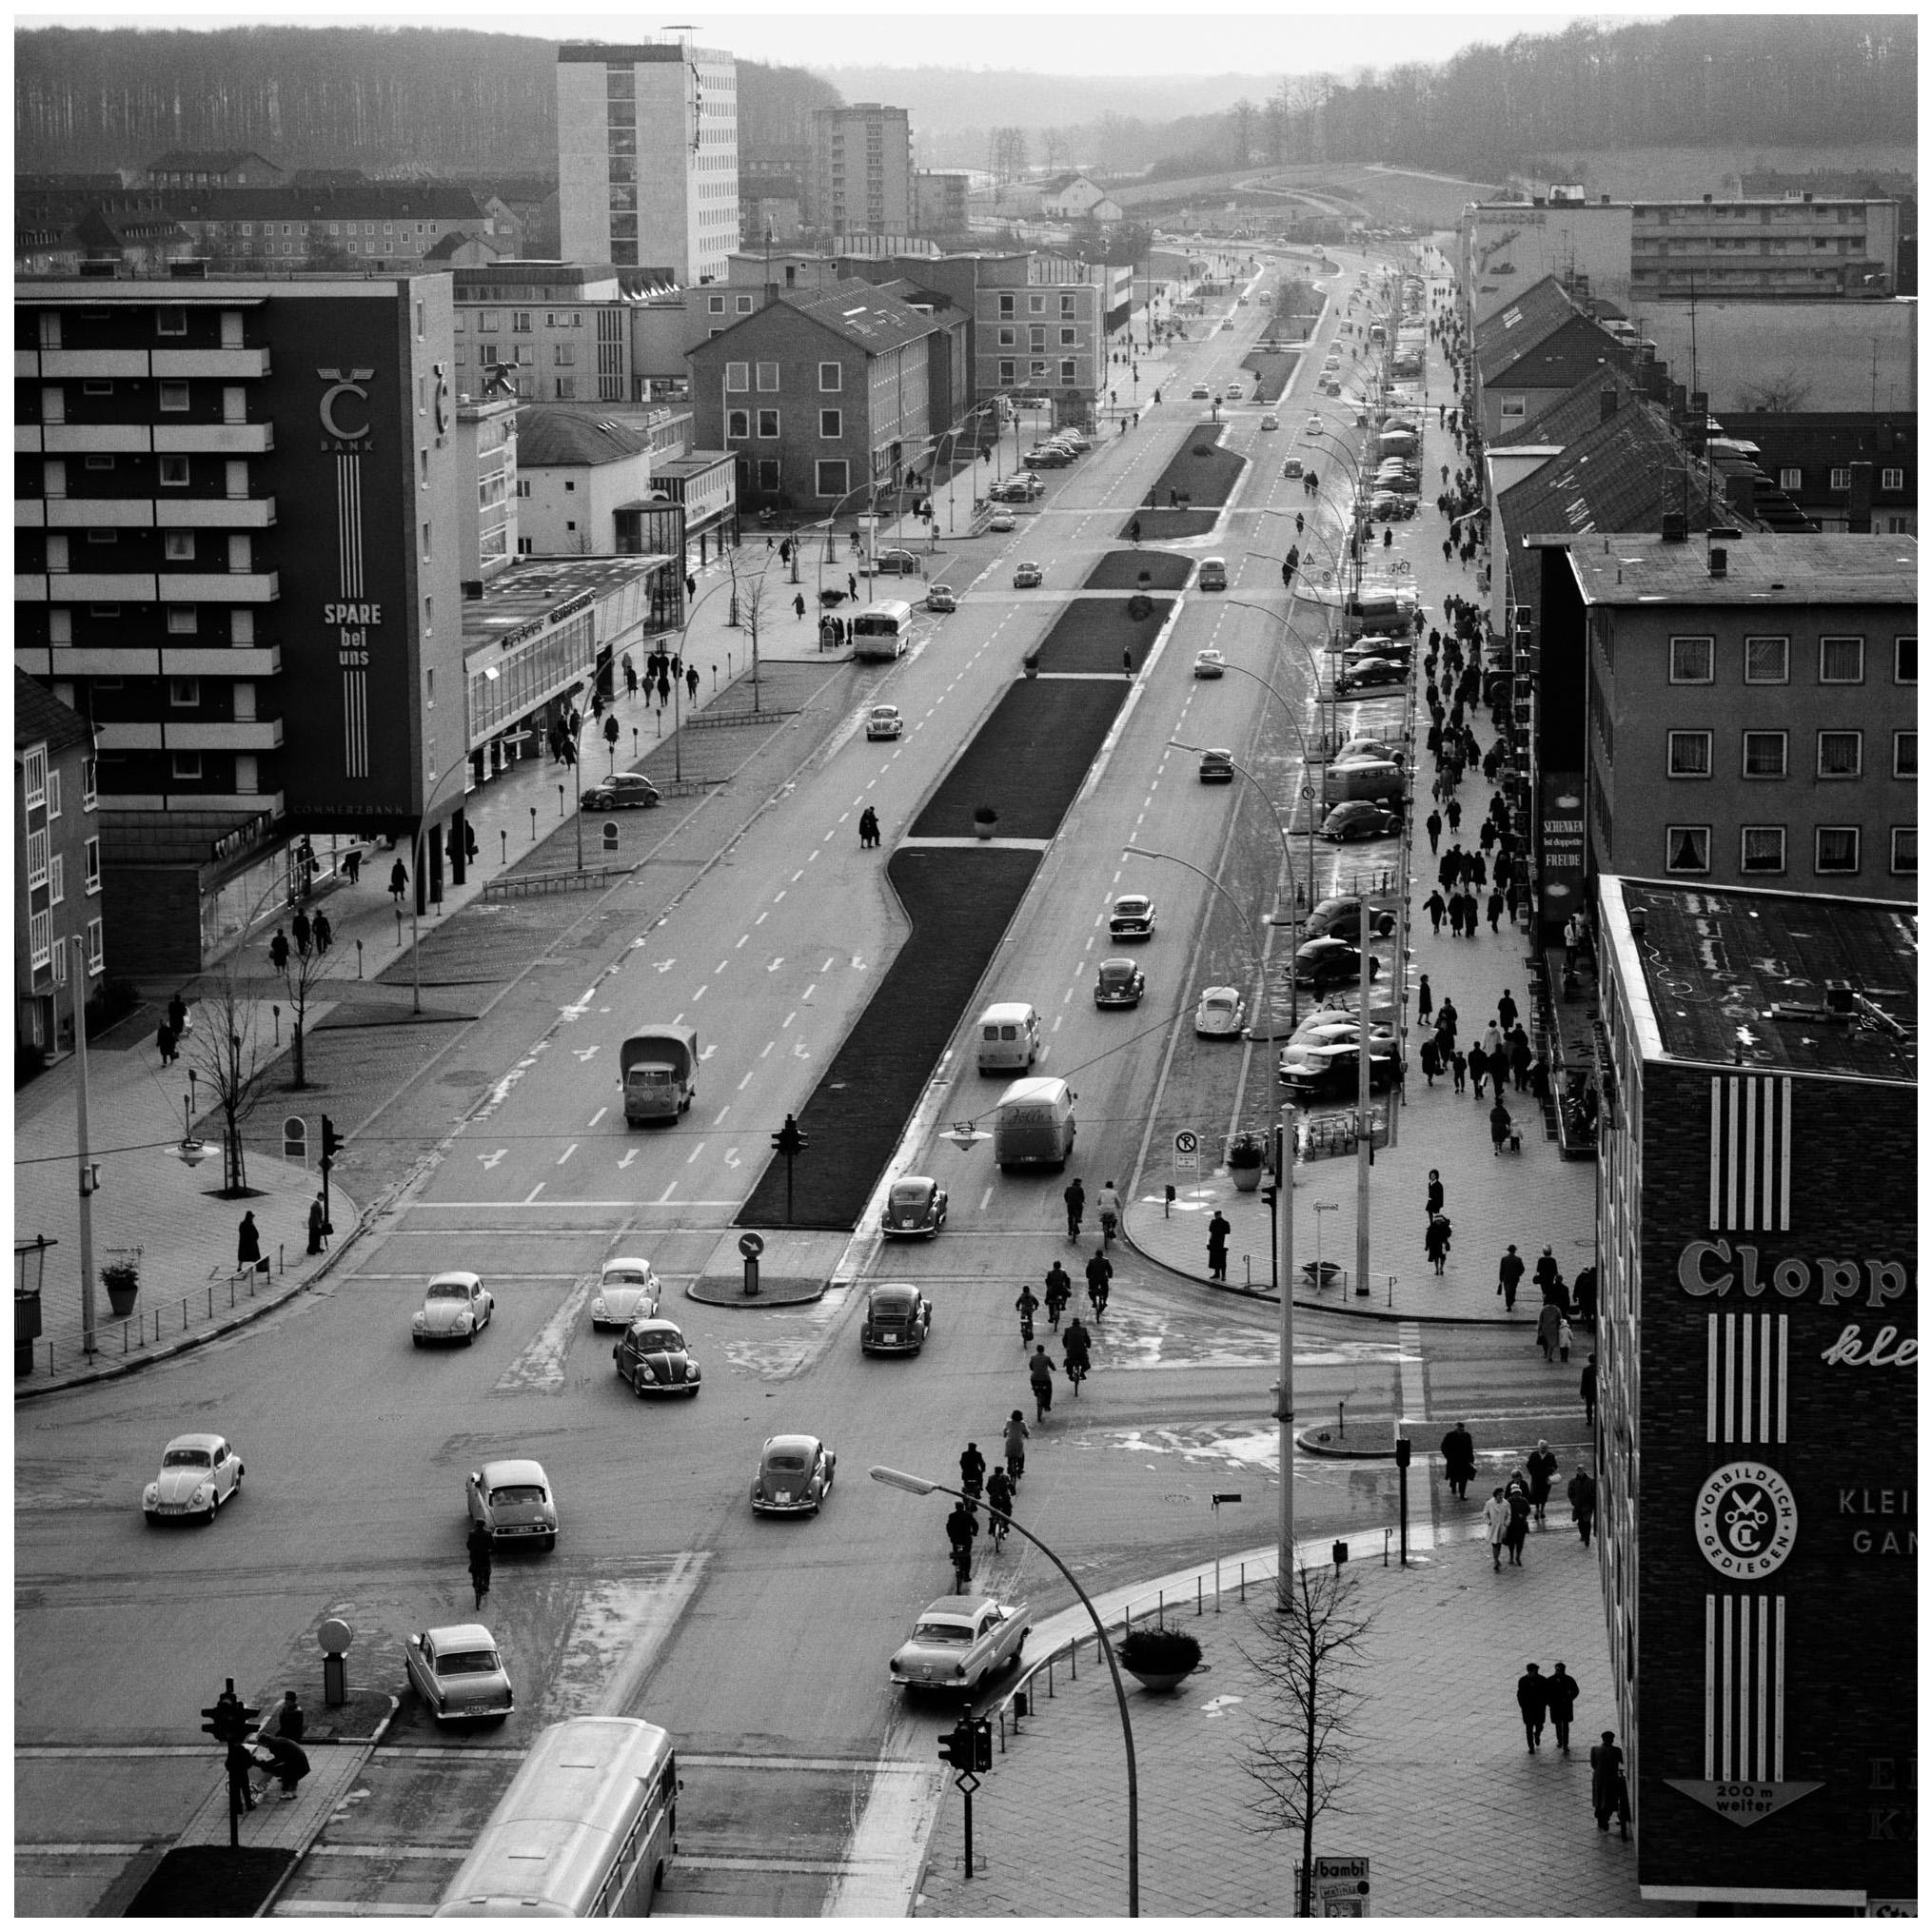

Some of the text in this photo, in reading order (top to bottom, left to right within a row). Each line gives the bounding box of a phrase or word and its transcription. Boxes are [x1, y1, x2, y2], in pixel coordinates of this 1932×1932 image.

[320, 441, 374, 451] BANK
[325, 603, 382, 624] SPARE
[341, 626, 366, 646] bei
[339, 650, 369, 665] uns
[293, 805, 404, 815] COMMERZBANK
[1544, 820, 1584, 833] SCHENKEN
[1546, 854, 1581, 866] FREUDE
[1701, 1468, 1792, 1517] VORBILDLICH
[1704, 1535, 1790, 1573] GEDIEGEN
[1716, 1785, 1773, 1798] 200 m
[1716, 1799, 1773, 1812] weiter
[1320, 1860, 1365, 1878] bambi
